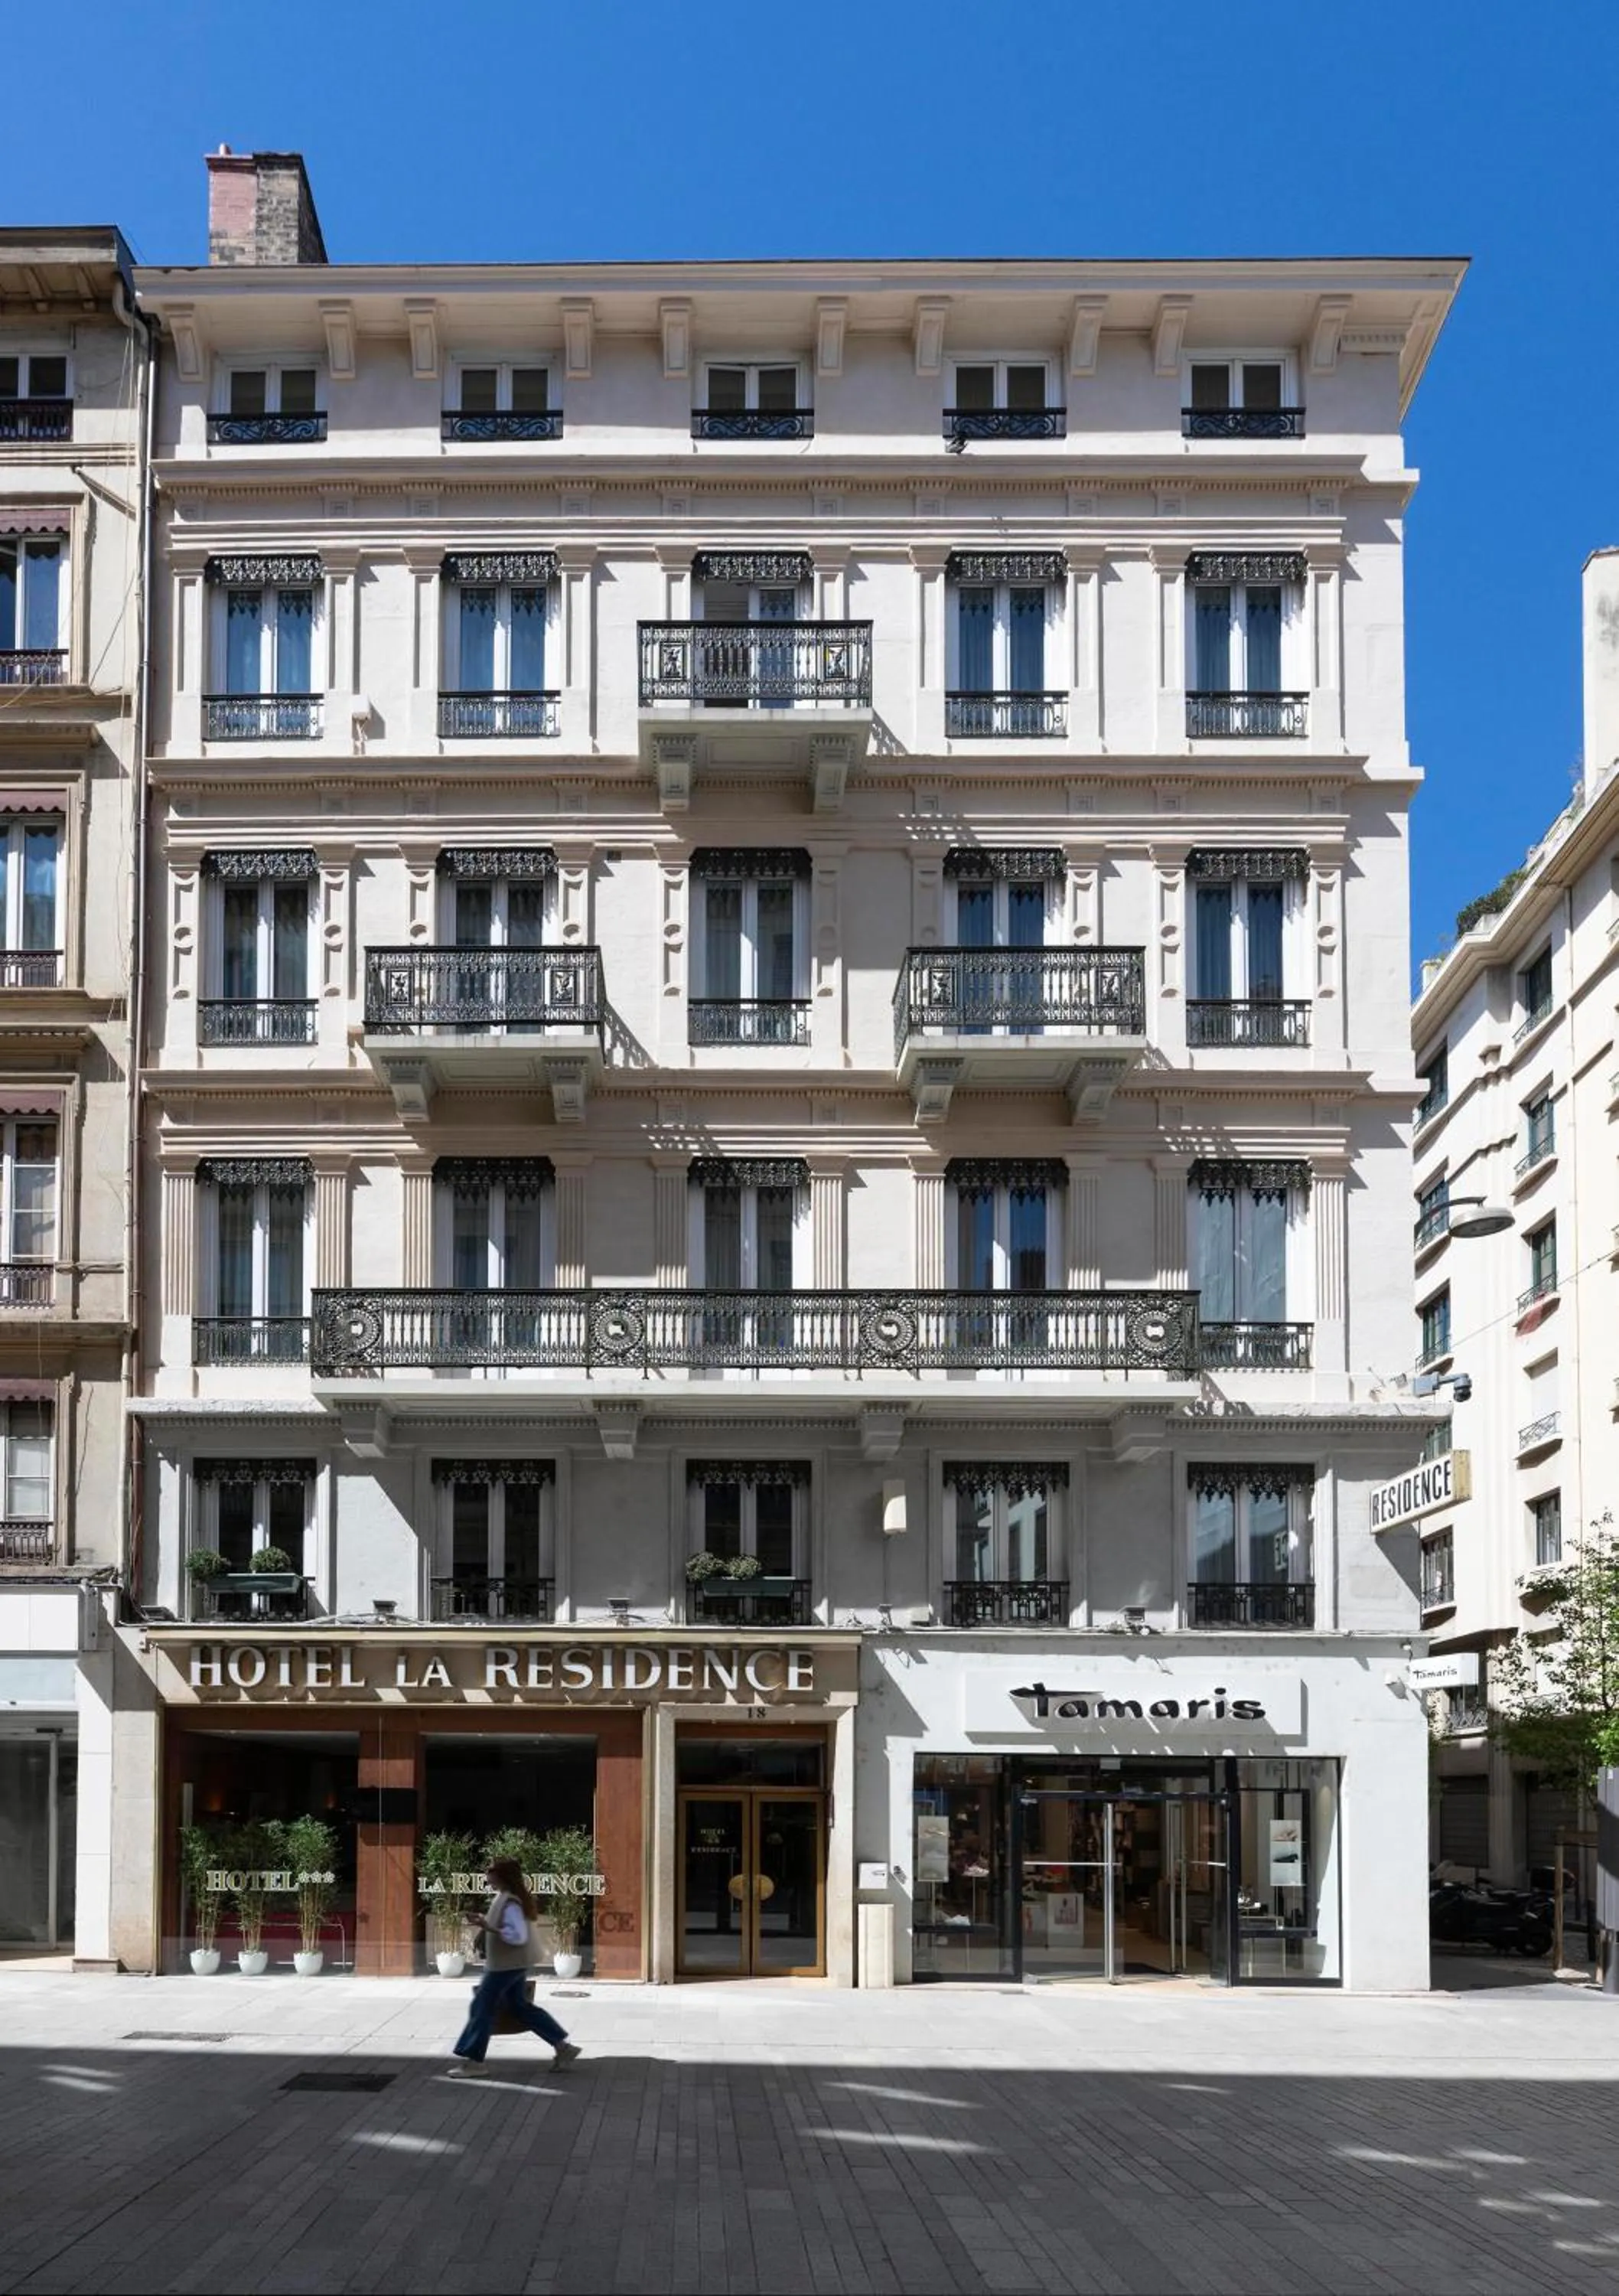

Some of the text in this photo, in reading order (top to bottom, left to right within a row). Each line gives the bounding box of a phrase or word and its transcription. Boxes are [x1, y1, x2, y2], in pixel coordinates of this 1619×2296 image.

[1372, 1459, 1451, 1527] RESIDENCE
[188, 1645, 815, 1691] HOTEL LA RESIDENCE
[748, 1707, 766, 1718] 18
[206, 1870, 606, 1896] HOTEL LA REDENCE
